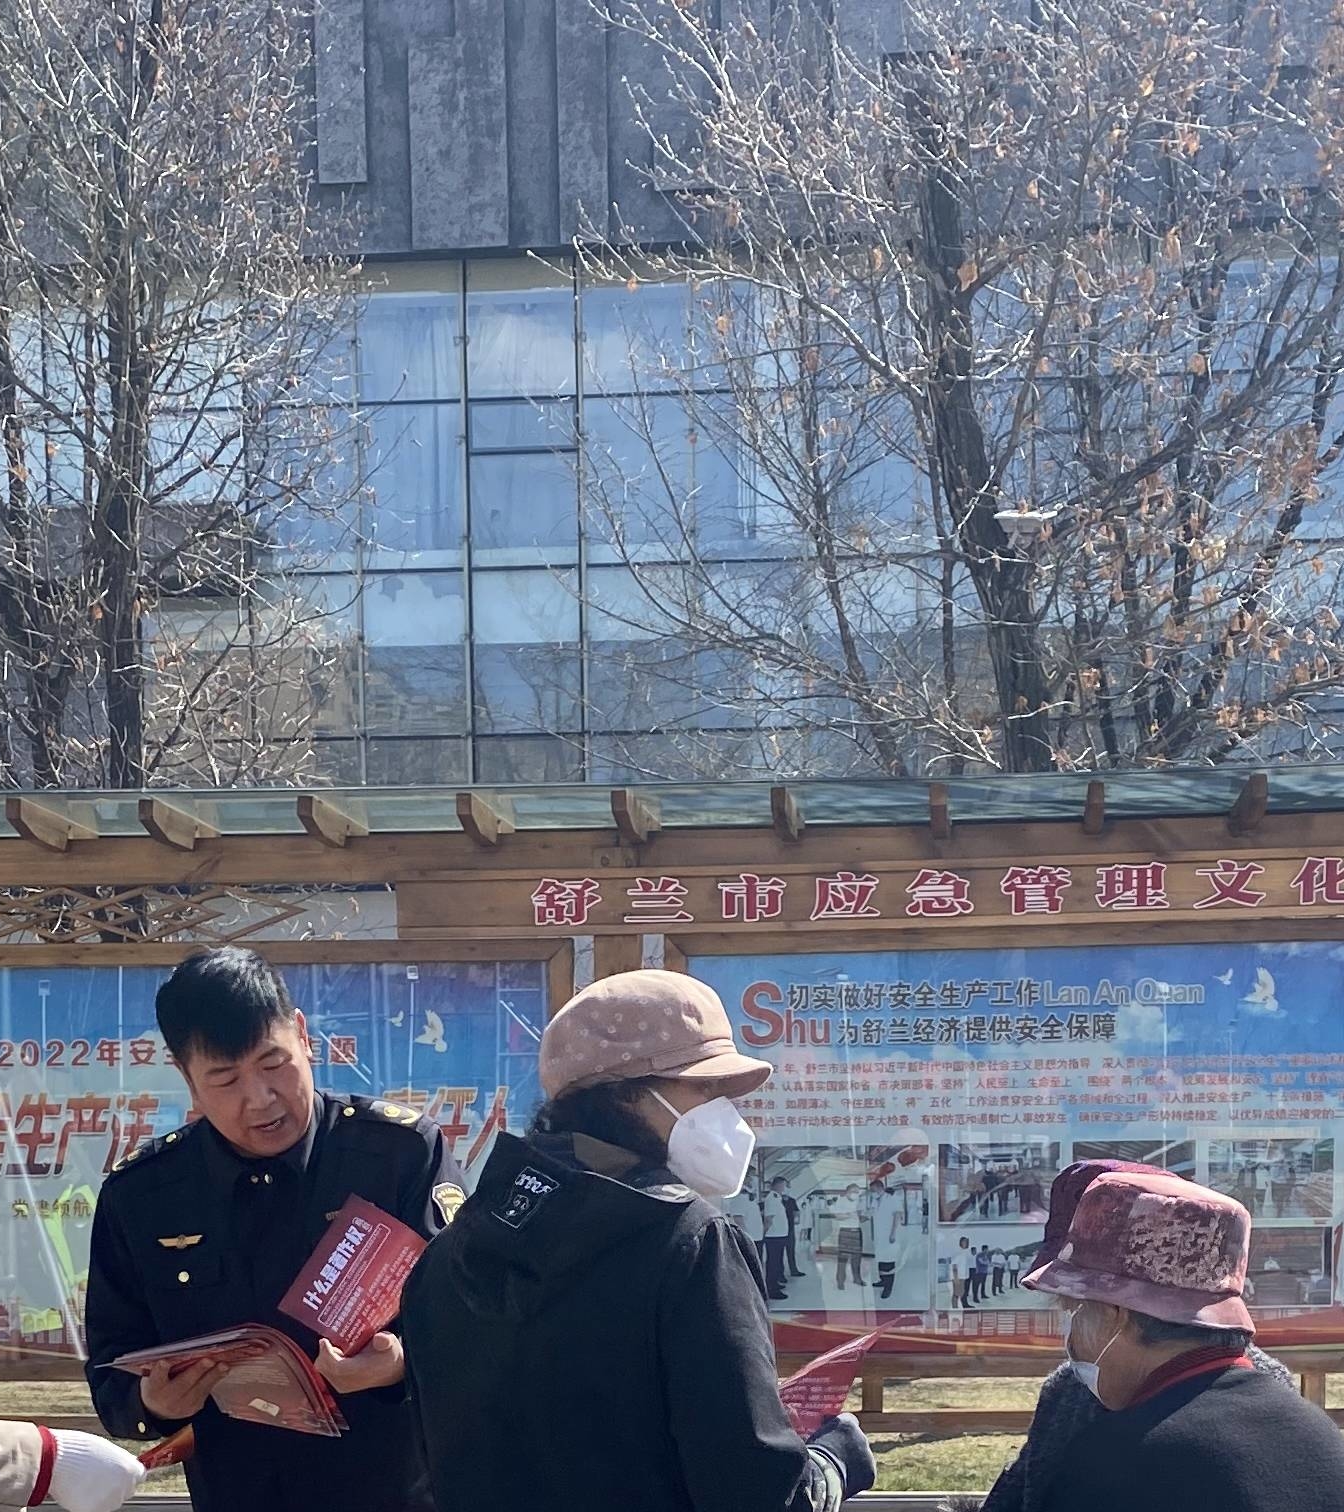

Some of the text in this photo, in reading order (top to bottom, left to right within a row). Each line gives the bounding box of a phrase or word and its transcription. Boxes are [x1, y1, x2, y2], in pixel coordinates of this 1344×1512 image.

[787, 979, 1039, 1010] 切实做好安全生产工作
[1044, 980, 1090, 1006] Lan
[1094, 979, 1131, 1006] An
[741, 980, 831, 1046] Shu
[838, 1012, 1116, 1045] 为舒兰经济提供安全保障
